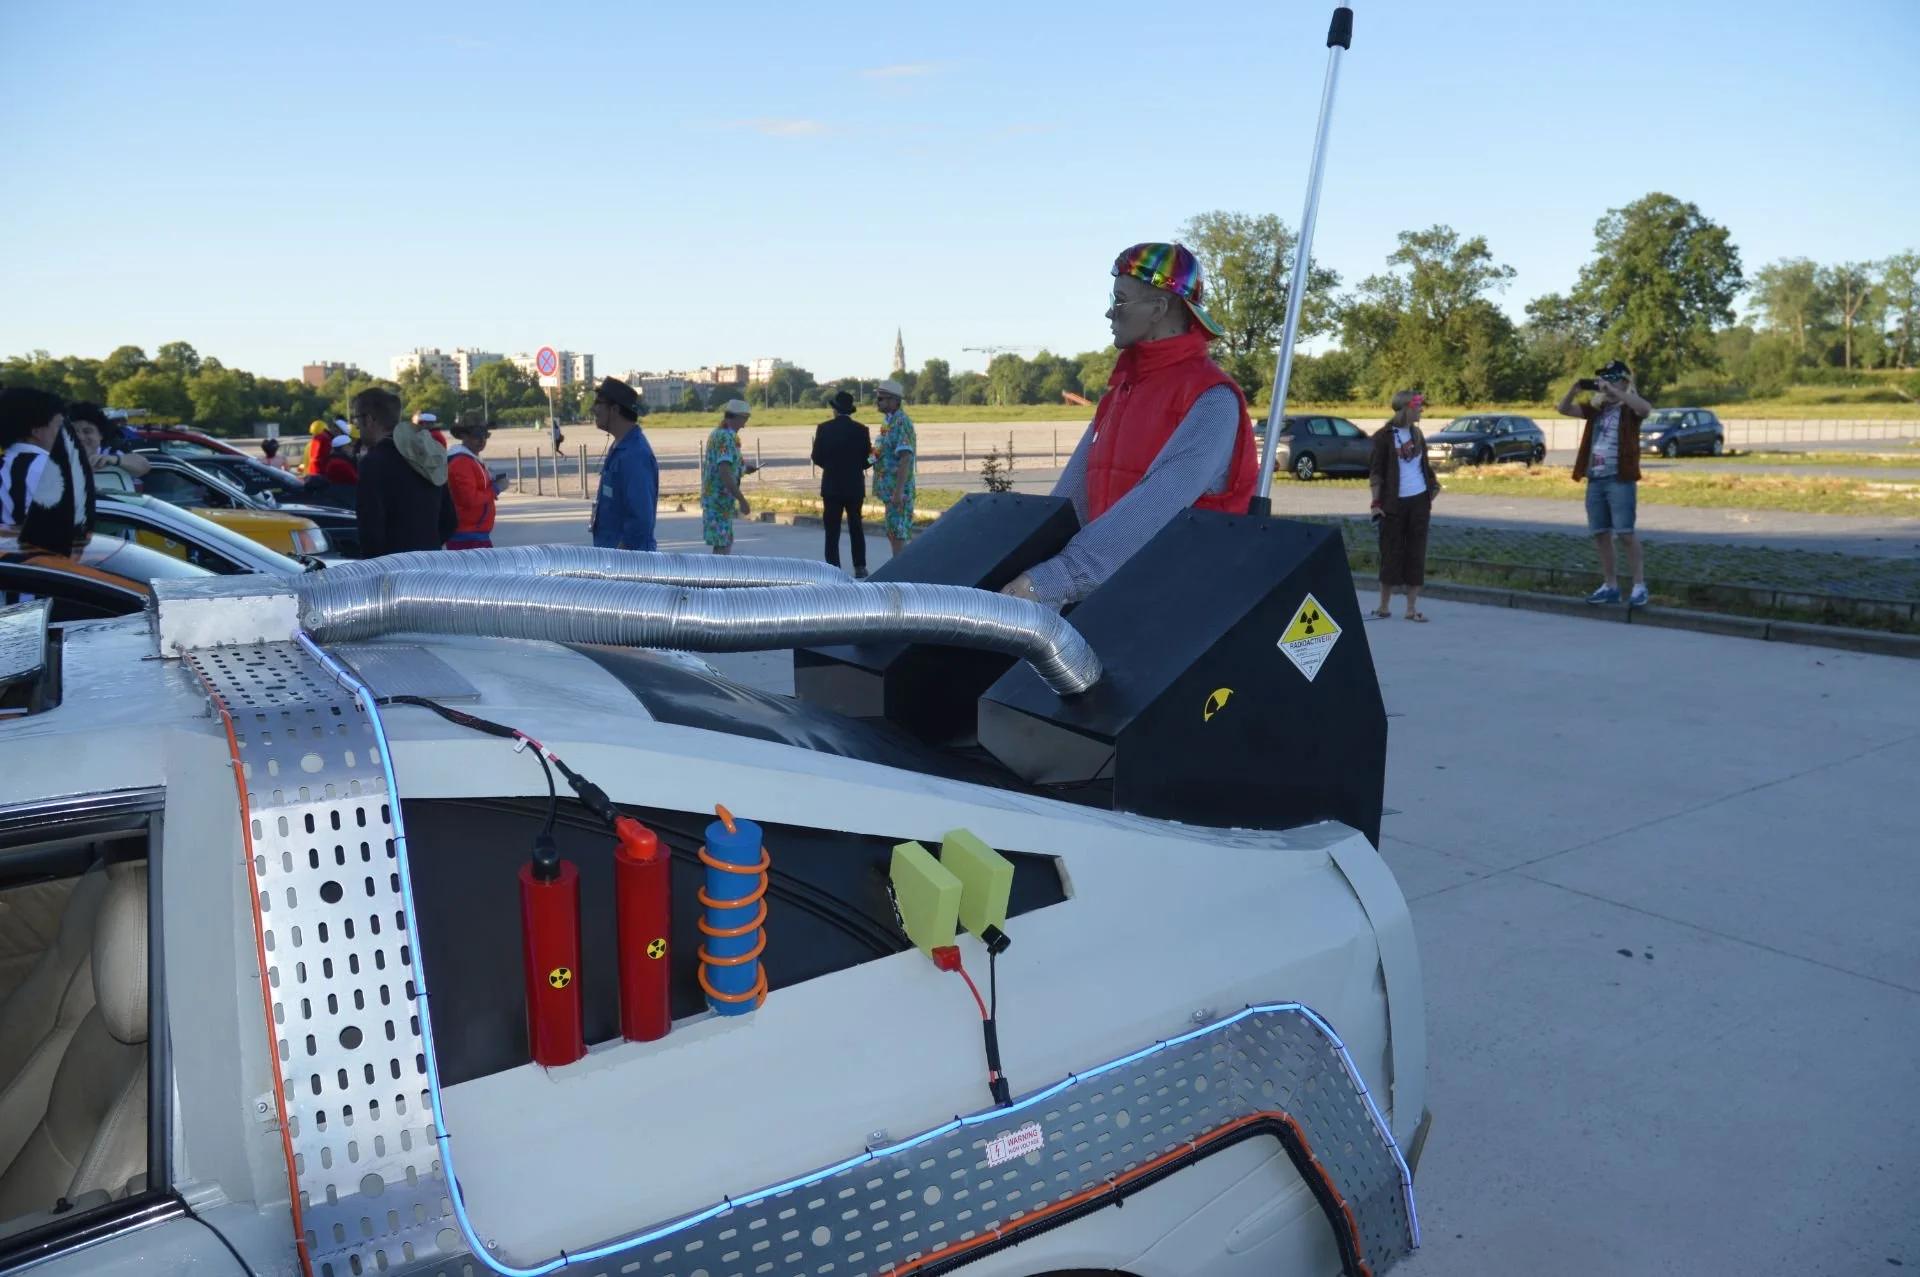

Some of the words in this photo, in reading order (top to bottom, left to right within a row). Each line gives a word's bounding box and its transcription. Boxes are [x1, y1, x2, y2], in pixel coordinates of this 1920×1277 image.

[1290, 635, 1325, 648] RADIOACTIVE
[1309, 665, 1313, 673] 7
[1008, 1130, 1038, 1146] WARNING
[1009, 1146, 1020, 1154] HIGH
[1020, 1138, 1039, 1149] VOLTAGE
